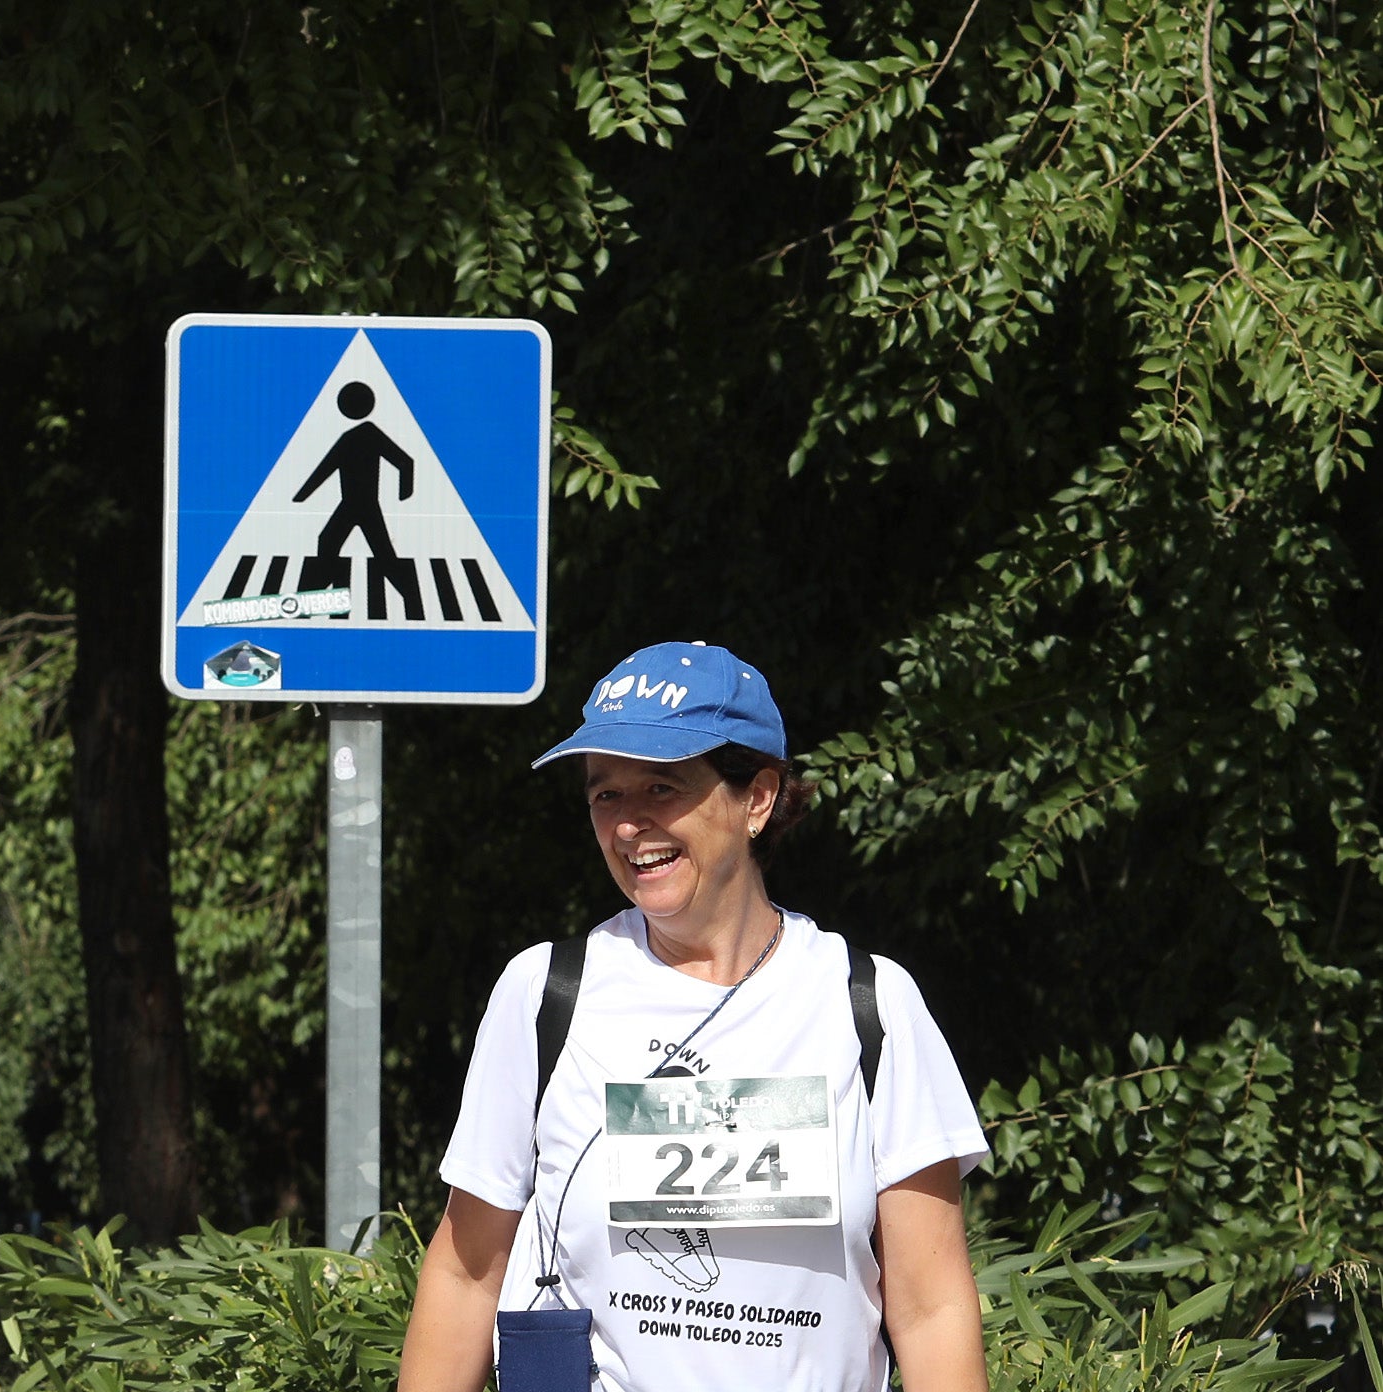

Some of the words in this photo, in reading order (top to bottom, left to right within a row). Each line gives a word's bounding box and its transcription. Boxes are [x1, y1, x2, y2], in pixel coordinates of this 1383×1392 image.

[300, 590, 350, 615] VERDES
[595, 674, 688, 709] DOWN
[648, 1039, 711, 1074] DOWN
[655, 1139, 788, 1195] 224
[666, 1203, 776, 1216] www.diputoledo.es
[609, 1291, 618, 1307] X
[621, 1293, 667, 1313] CROSS
[672, 1297, 682, 1314] Y
[686, 1299, 735, 1320] PASEO
[739, 1304, 822, 1328] SOLIDARIO
[639, 1319, 681, 1338] DOWN
[685, 1324, 741, 1344] TOLEDO
[746, 1331, 783, 1347] 2025
